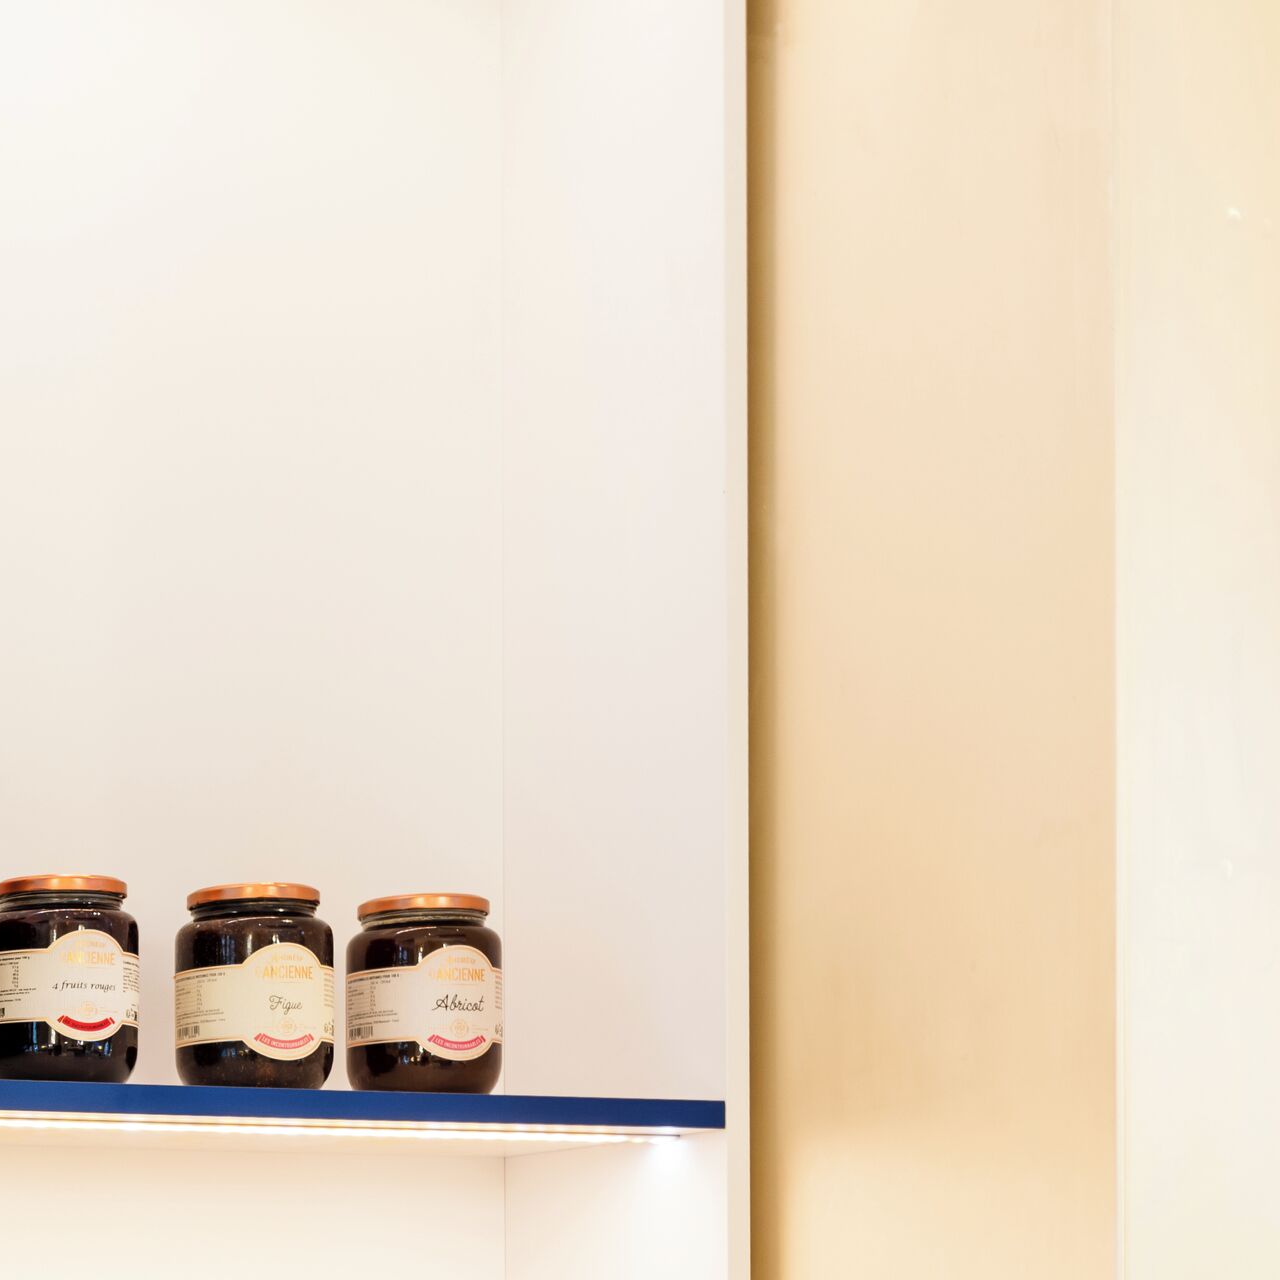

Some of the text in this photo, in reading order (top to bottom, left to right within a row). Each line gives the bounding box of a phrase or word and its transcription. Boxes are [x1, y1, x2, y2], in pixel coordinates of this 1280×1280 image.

[51, 980, 116, 993] 4 fruits rouges
[269, 994, 303, 1015] Figue
[431, 994, 485, 1012] Abricot
